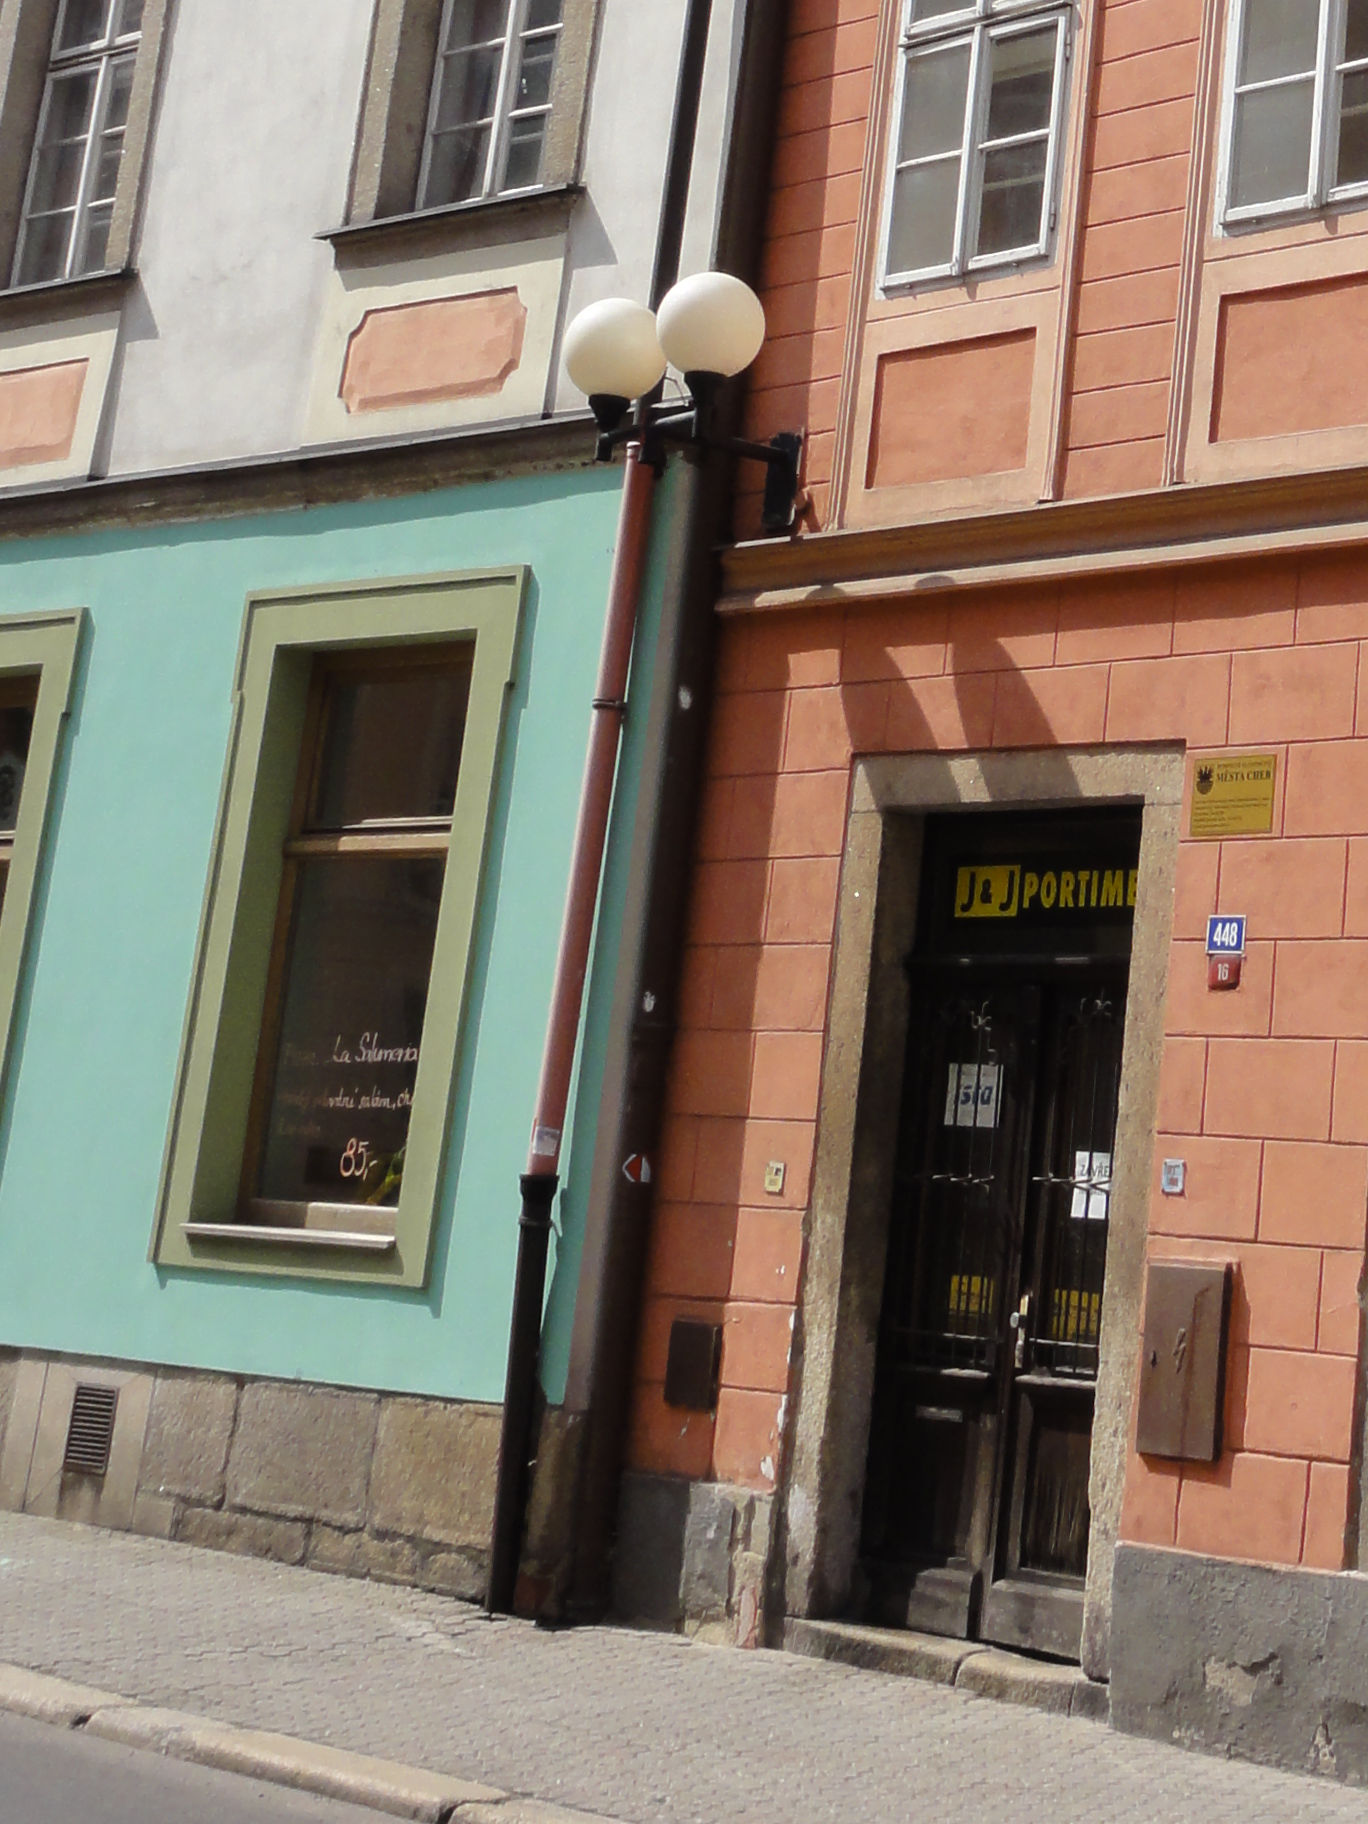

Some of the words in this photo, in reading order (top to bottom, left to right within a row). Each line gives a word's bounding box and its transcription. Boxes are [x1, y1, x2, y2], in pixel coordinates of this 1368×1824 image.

[1246, 768, 1272, 781] CHEB
[1213, 922, 1238, 946] 448
[1217, 963, 1230, 981] 16
[333, 1034, 352, 1064] La
